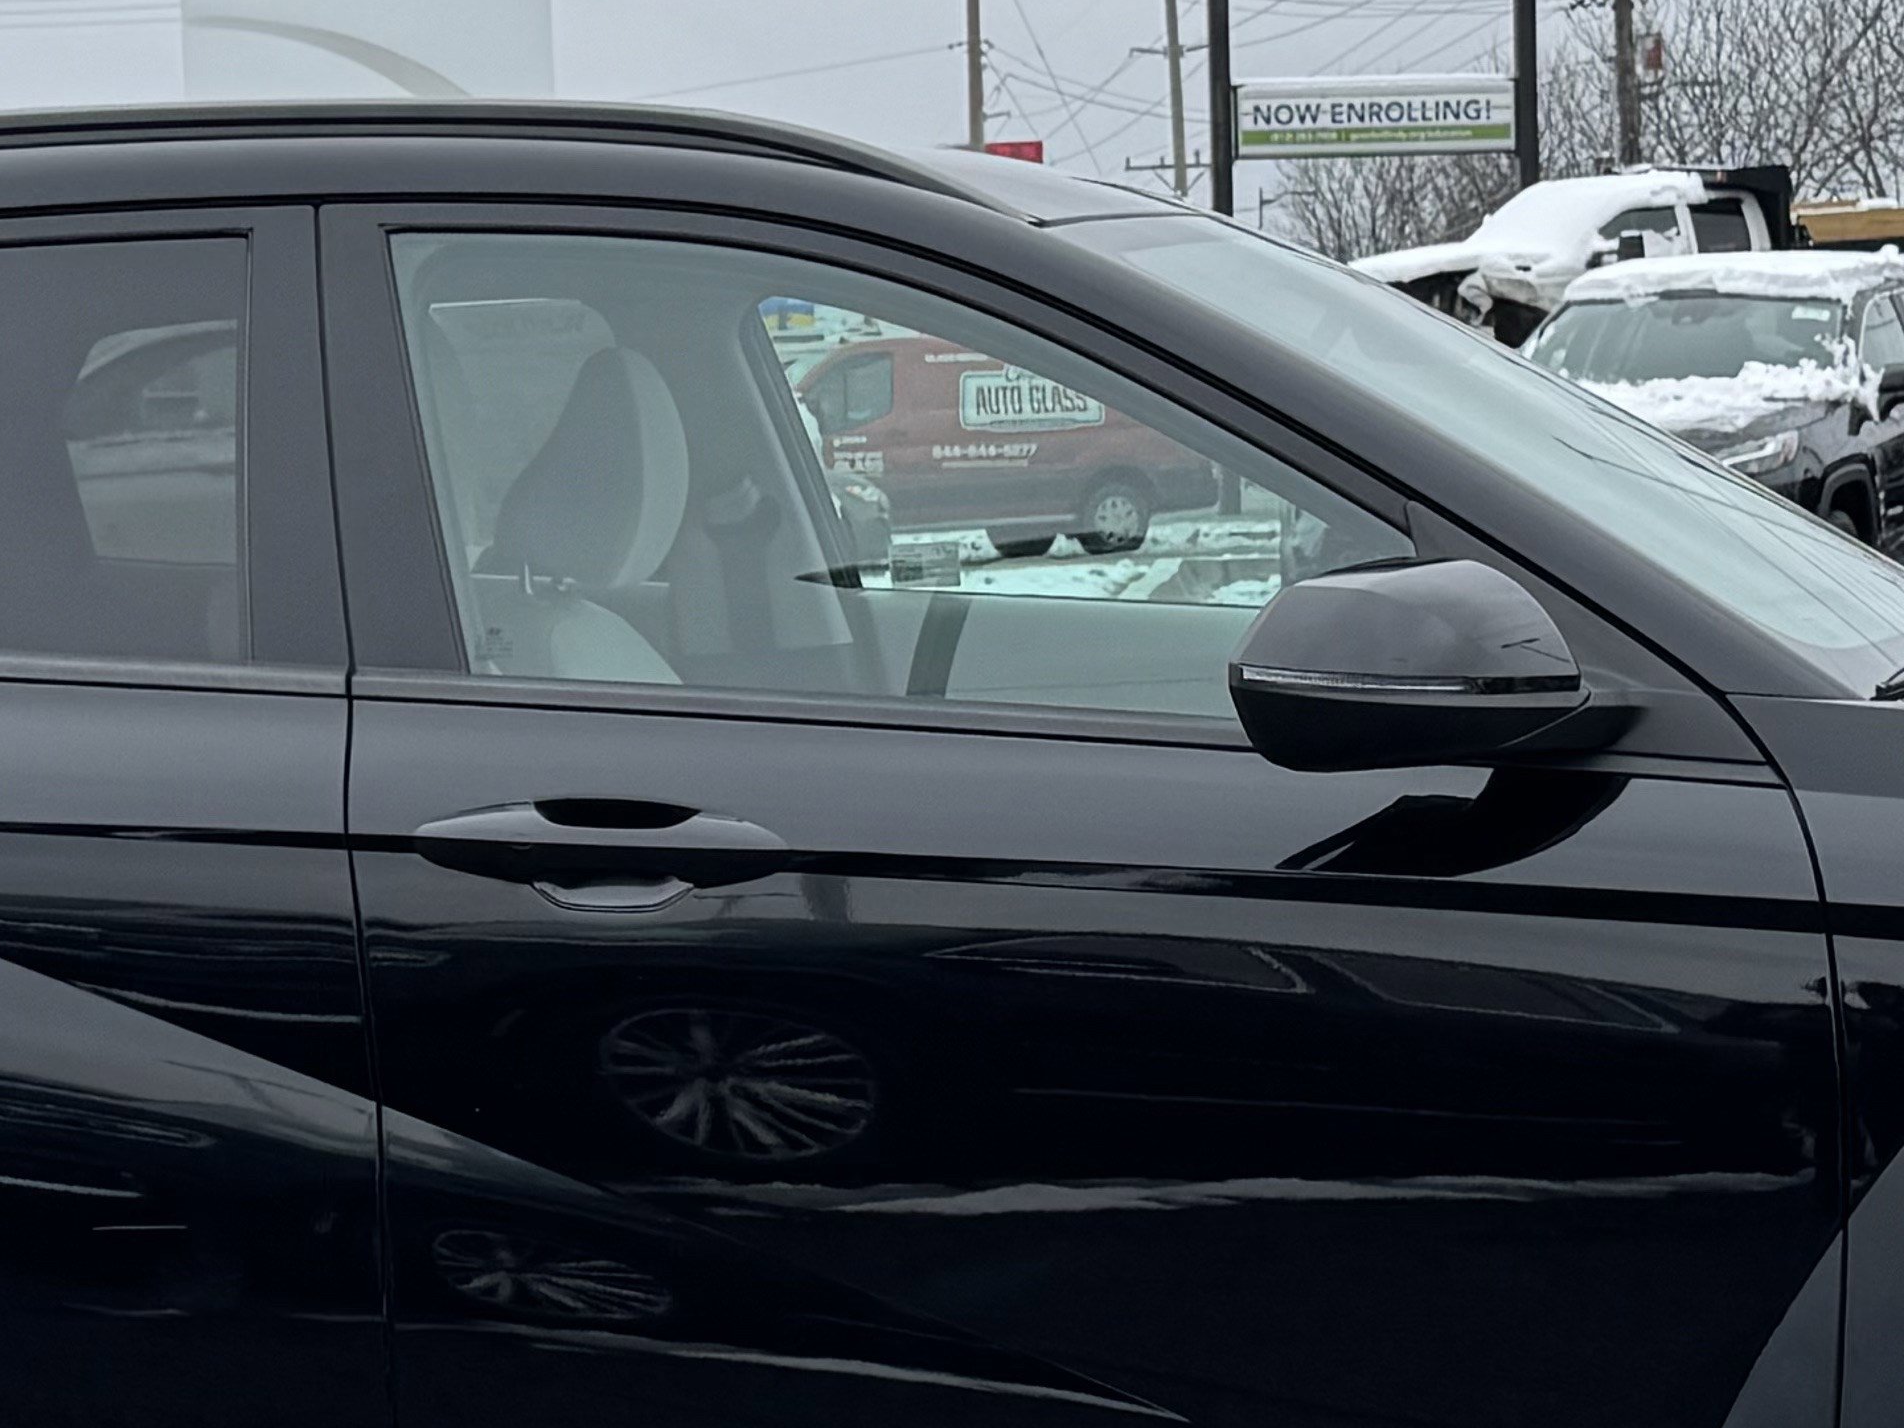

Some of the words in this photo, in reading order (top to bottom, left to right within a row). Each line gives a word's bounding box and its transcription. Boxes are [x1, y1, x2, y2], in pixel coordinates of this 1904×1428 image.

[1253, 104, 1321, 125] NOW
[1330, 100, 1491, 124] ENROLLING!
[976, 386, 1023, 415] AUTO
[1029, 384, 1088, 413] GLASS
